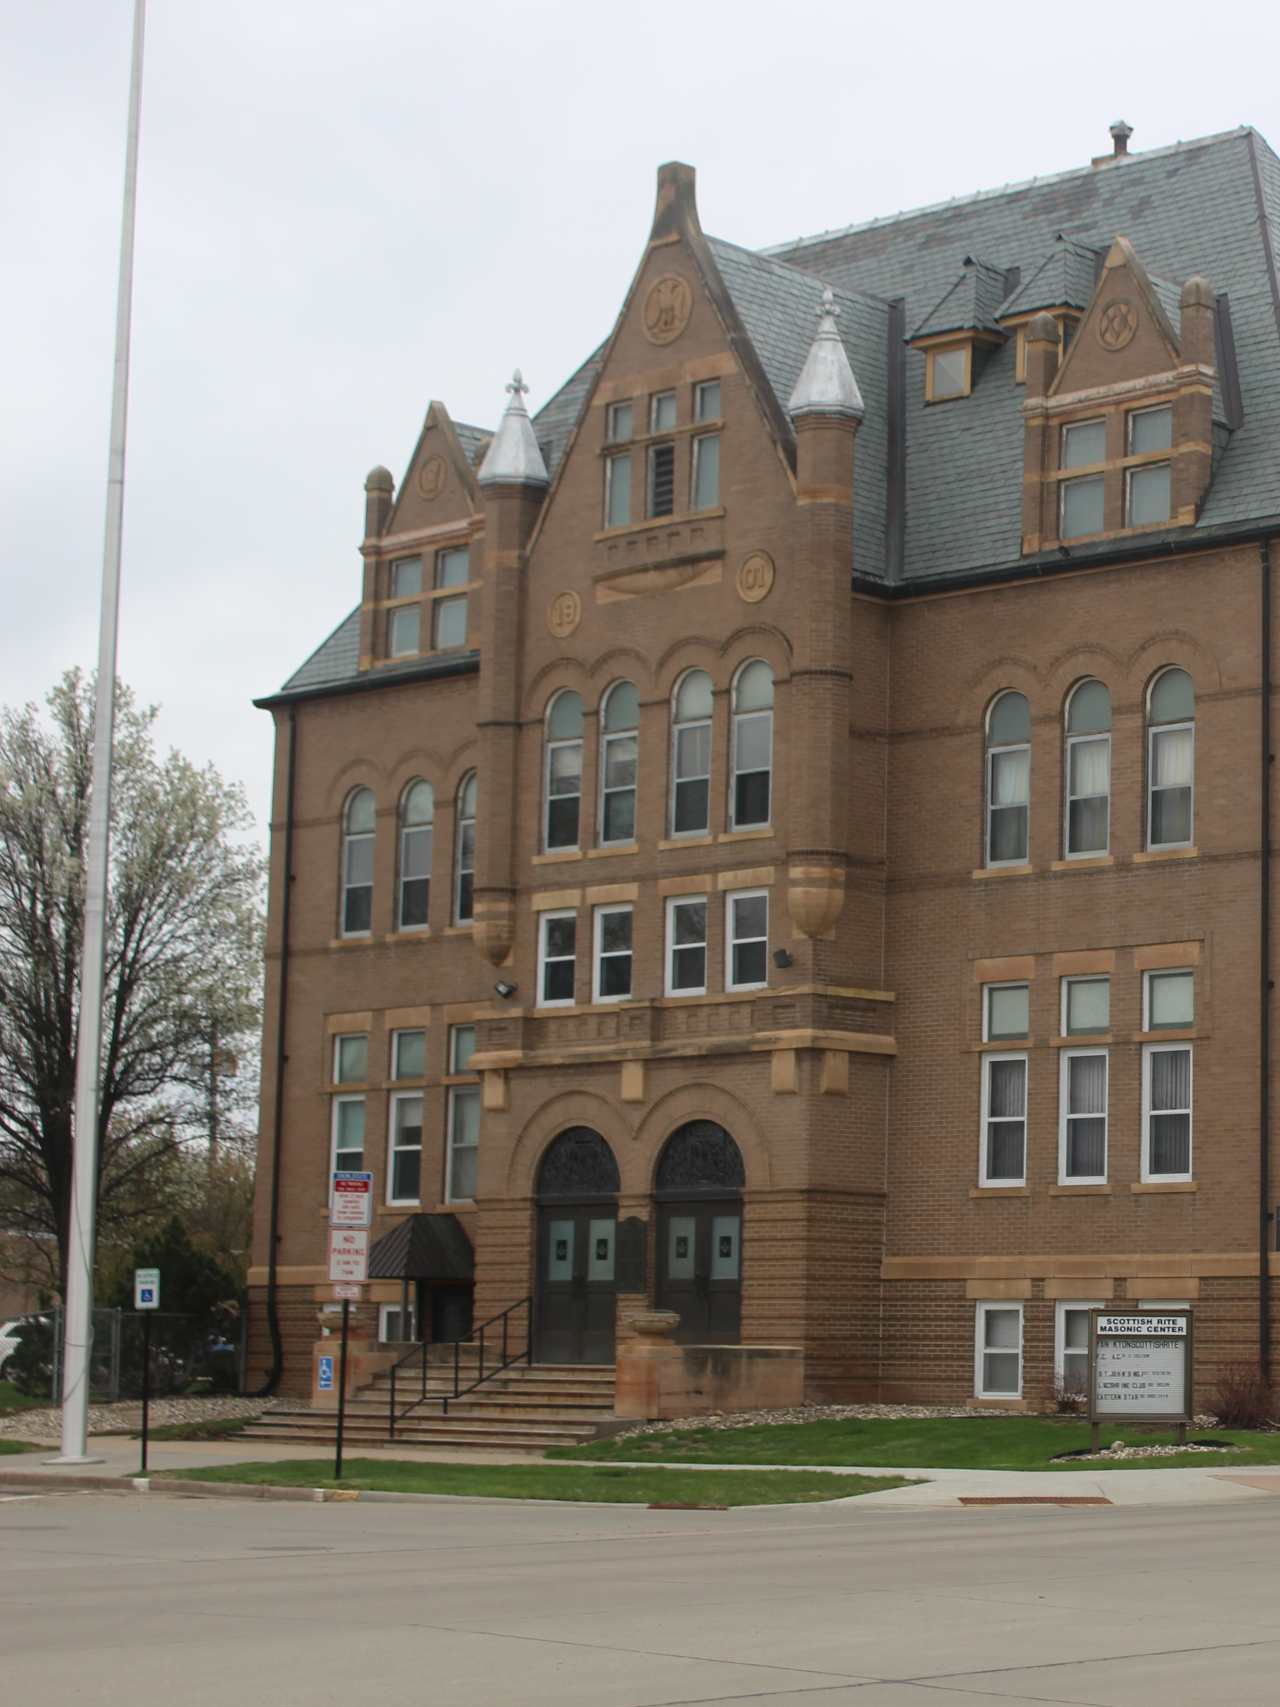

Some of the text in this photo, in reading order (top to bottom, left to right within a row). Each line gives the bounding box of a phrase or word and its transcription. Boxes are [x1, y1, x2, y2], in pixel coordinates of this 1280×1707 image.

[342, 1236, 356, 1244] NO
[332, 1247, 366, 1256] PARKING
[1106, 1318, 1178, 1326] SCOTTISH RITE
[1100, 1325, 1142, 1333] MASONIC
